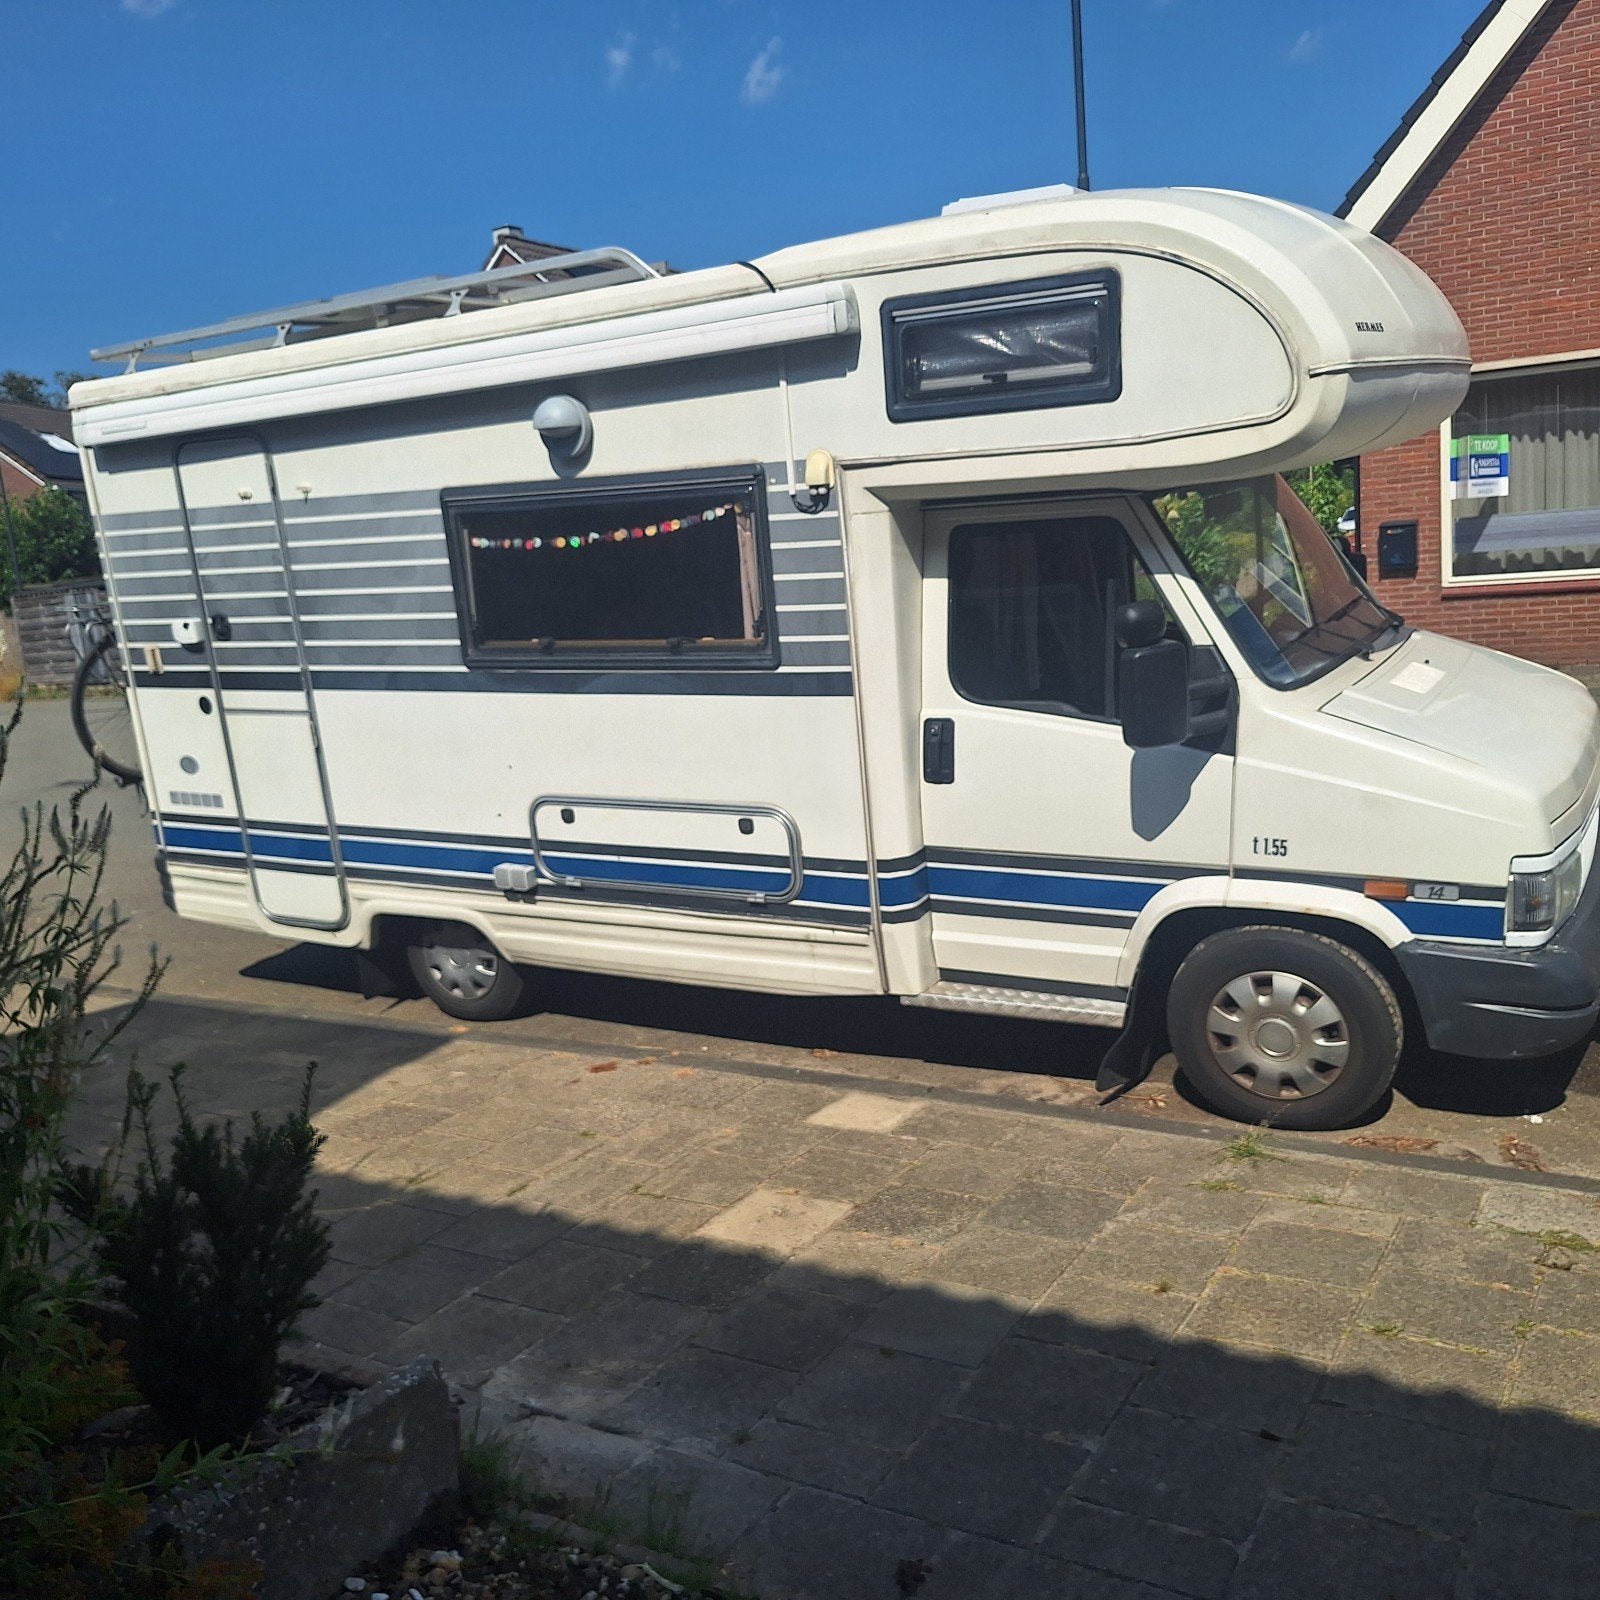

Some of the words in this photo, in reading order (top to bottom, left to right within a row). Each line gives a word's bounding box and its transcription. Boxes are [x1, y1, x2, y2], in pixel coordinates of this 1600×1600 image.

[1355, 321, 1384, 332] HERMES
[1264, 837, 1288, 857] 1.55
[1428, 886, 1445, 899] 14
